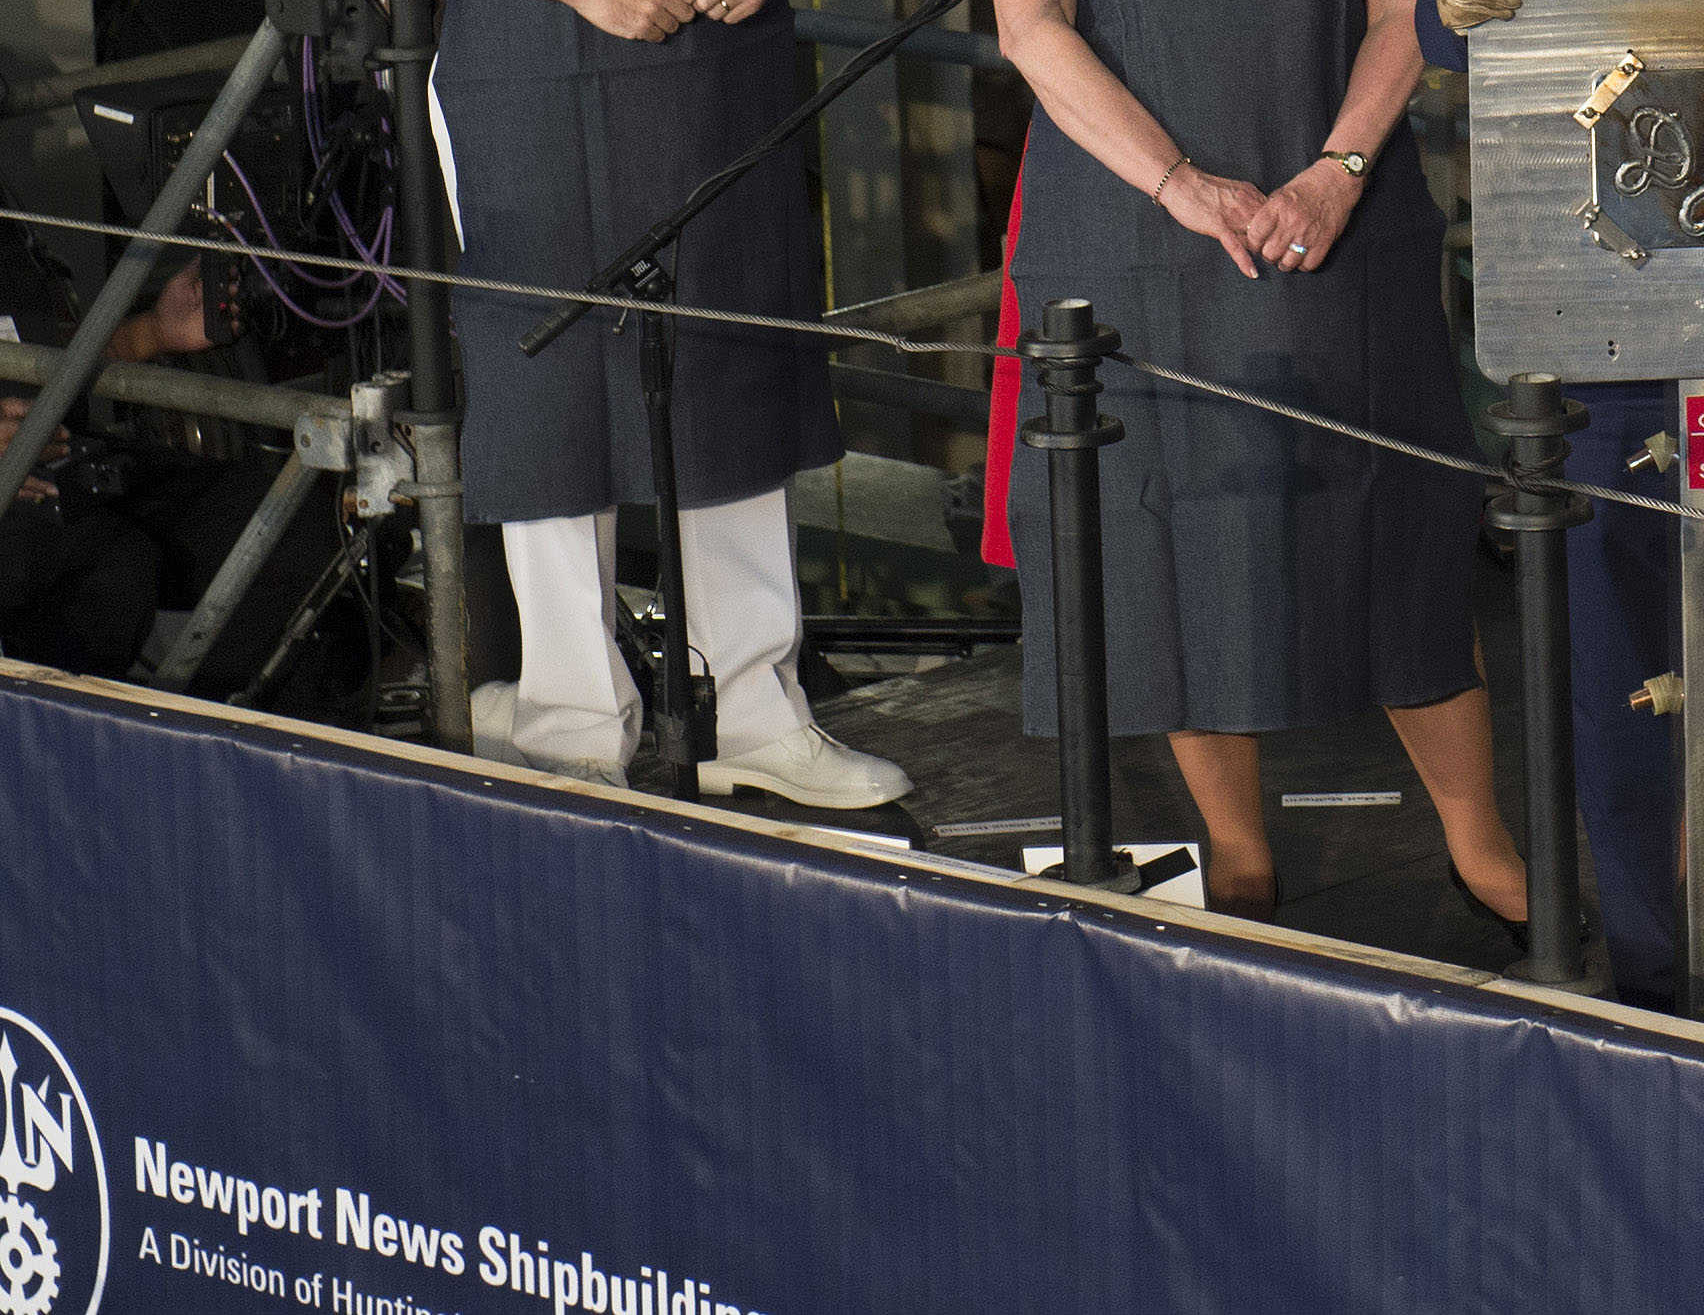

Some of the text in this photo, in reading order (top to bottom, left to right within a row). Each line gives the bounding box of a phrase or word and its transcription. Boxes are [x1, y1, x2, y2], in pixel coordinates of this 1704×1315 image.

[135, 1136, 778, 1315] Newport News Shipbuildi
[138, 1227, 162, 1264] A
[170, 1233, 285, 1298] Division
[295, 1273, 323, 1308] of
